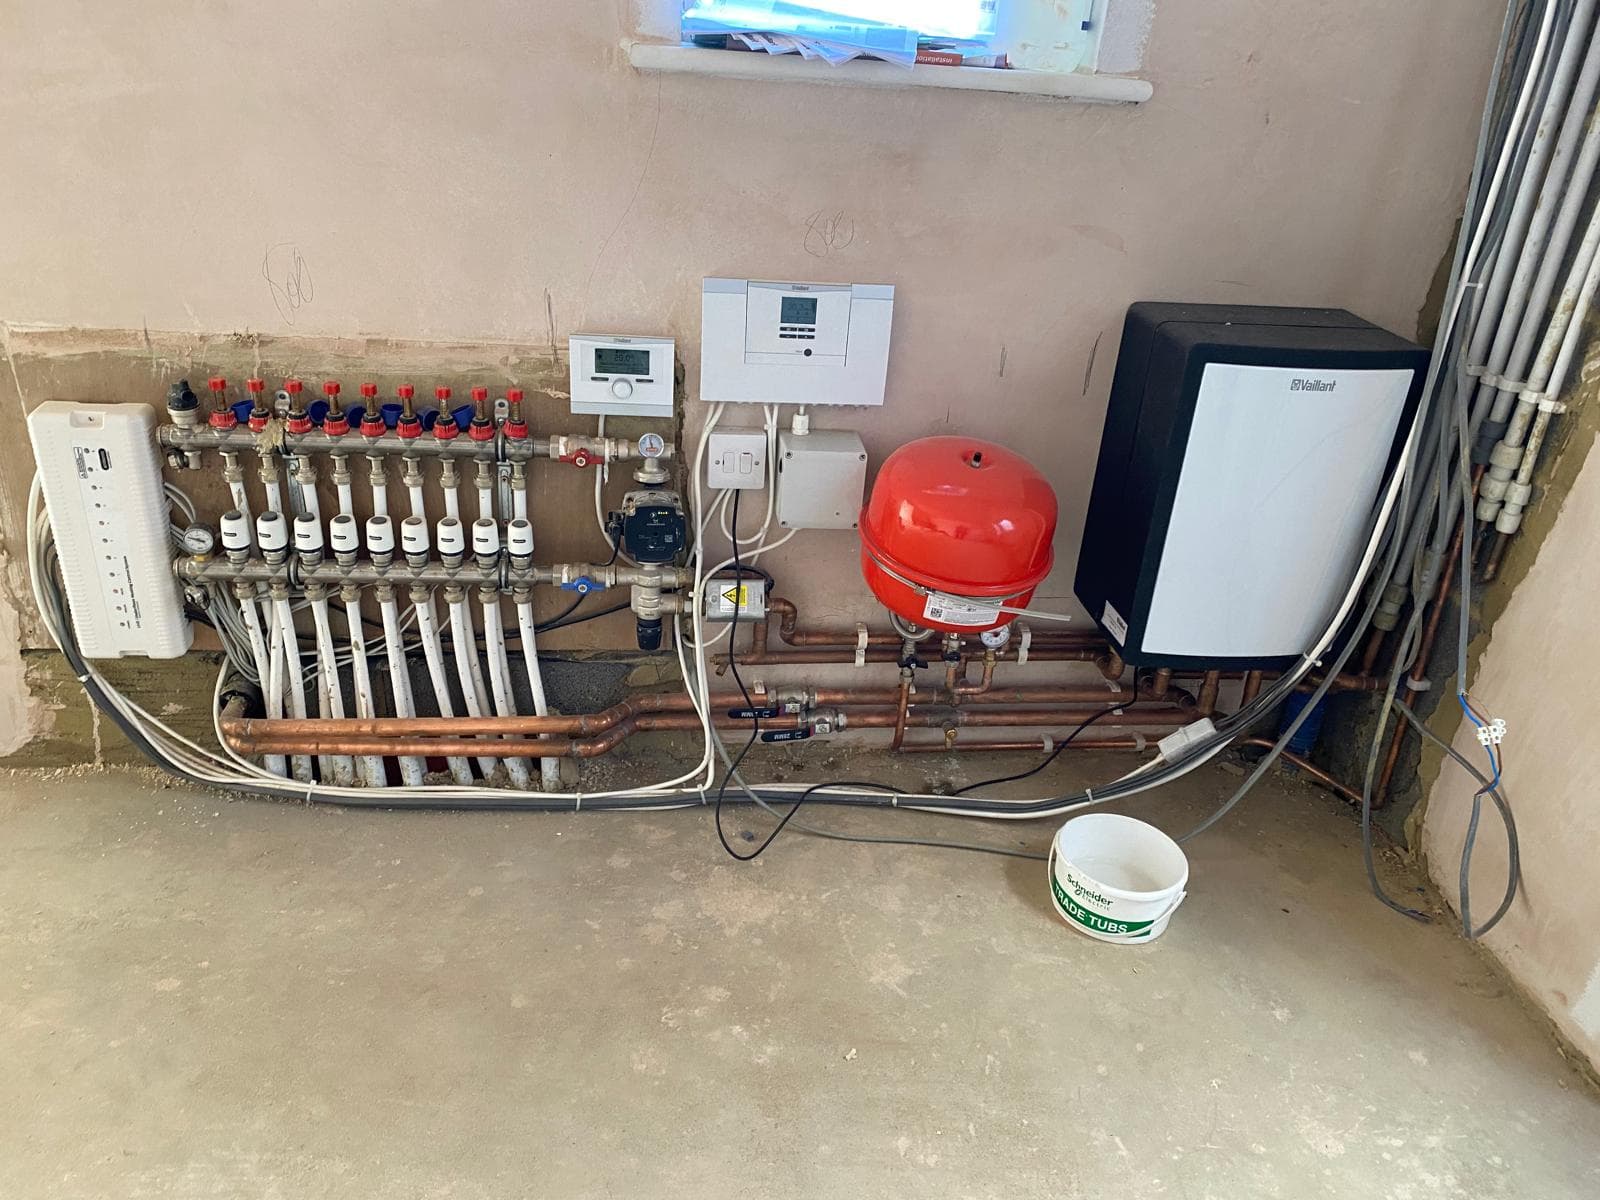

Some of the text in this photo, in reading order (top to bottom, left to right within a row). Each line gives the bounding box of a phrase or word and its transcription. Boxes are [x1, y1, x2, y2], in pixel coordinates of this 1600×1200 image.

[1301, 379, 1336, 391] Vaillant
[1067, 873, 1114, 906] Schneider
[1055, 882, 1128, 933] TRADE TUBS
